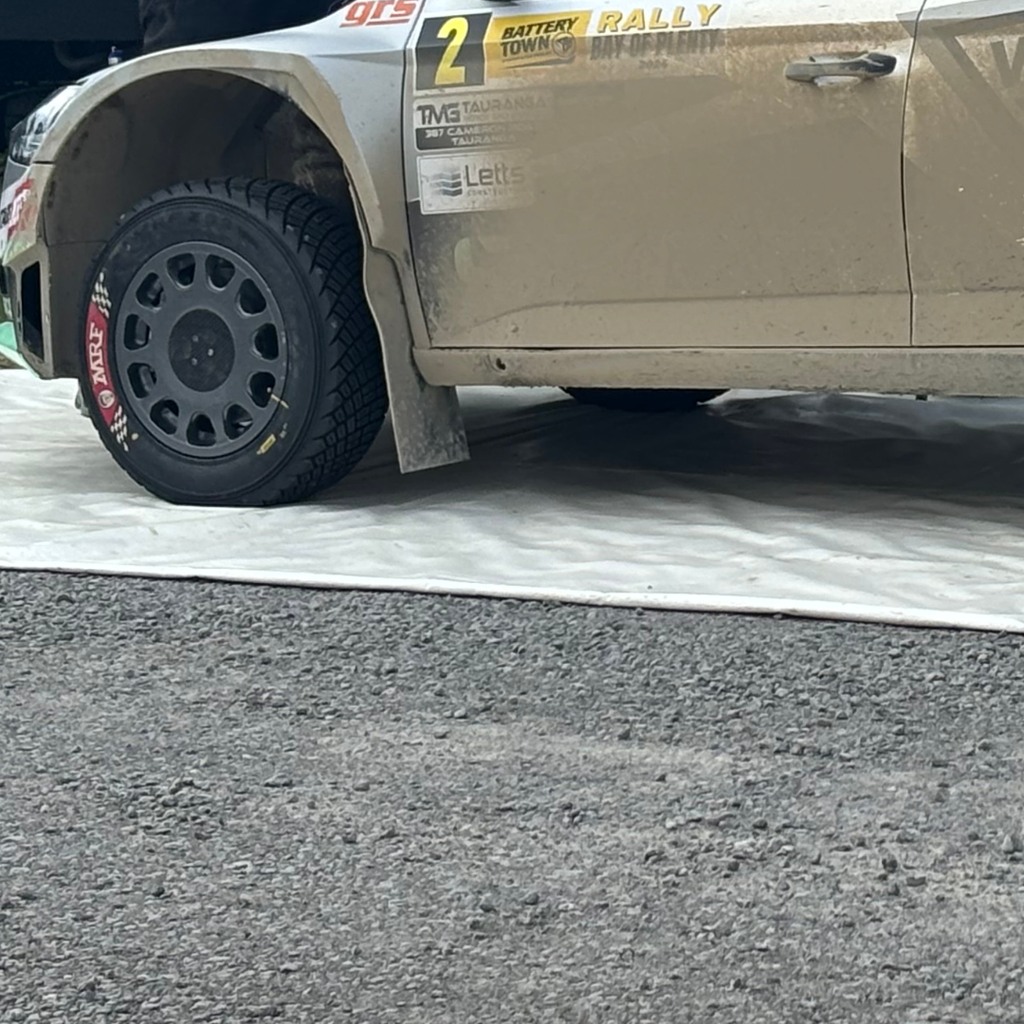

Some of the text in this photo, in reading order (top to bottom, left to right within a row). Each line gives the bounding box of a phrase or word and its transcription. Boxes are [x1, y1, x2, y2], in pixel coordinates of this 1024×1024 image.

[502, 16, 580, 39] BATTERY
[598, 3, 722, 33] RALLY
[434, 17, 469, 85] 2
[501, 35, 552, 57] TOWN
[591, 34, 625, 61] BAY
[655, 28, 722, 56] PLENTY
[417, 102, 461, 125] TMG
[462, 96, 547, 114] TAURANGA
[465, 163, 525, 186] Letts
[90, 322, 108, 386] MRF
